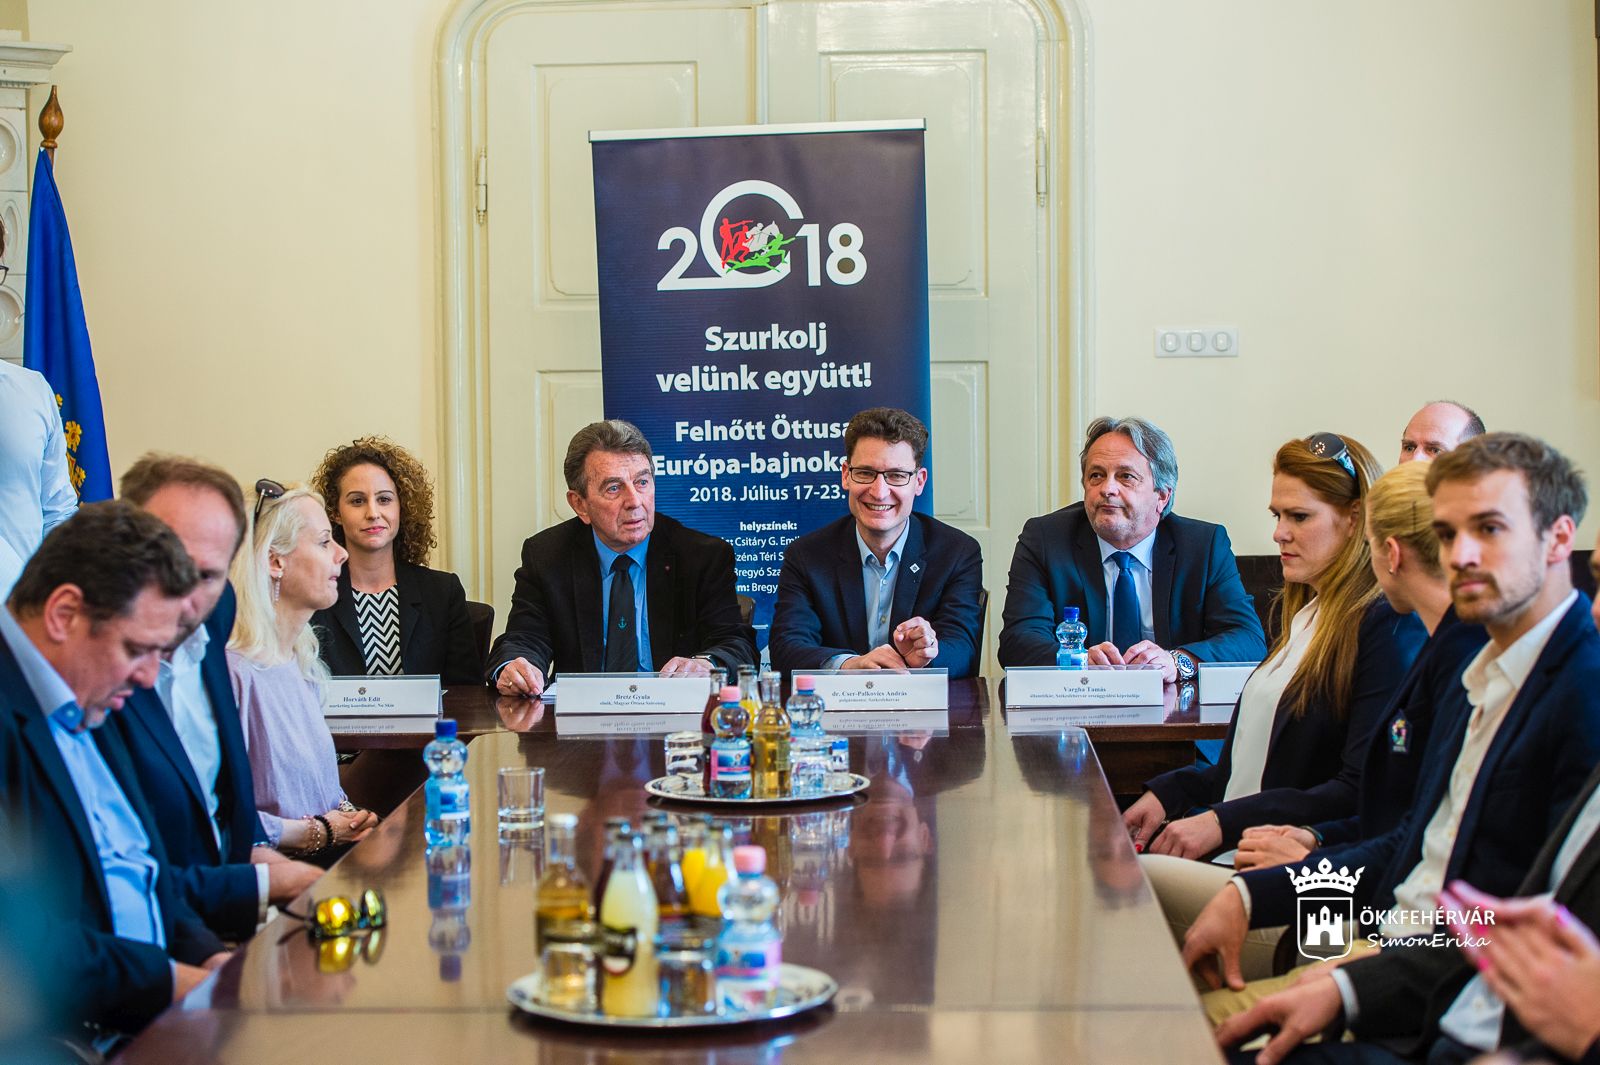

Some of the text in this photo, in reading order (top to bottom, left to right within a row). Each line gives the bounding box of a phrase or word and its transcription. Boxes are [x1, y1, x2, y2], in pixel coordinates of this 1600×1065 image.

[705, 322, 827, 355] Szurkolj
[656, 362, 873, 396] velünk együtt!
[675, 419, 766, 442] Felnőtt
[690, 484, 846, 502] 2018. Július 17-23.
[740, 520, 798, 533] helyszínek:
[735, 536, 767, 548] Csitáry
[768, 537, 779, 546] G.
[734, 551, 758, 562] zéna
[759, 551, 777, 561] Téri
